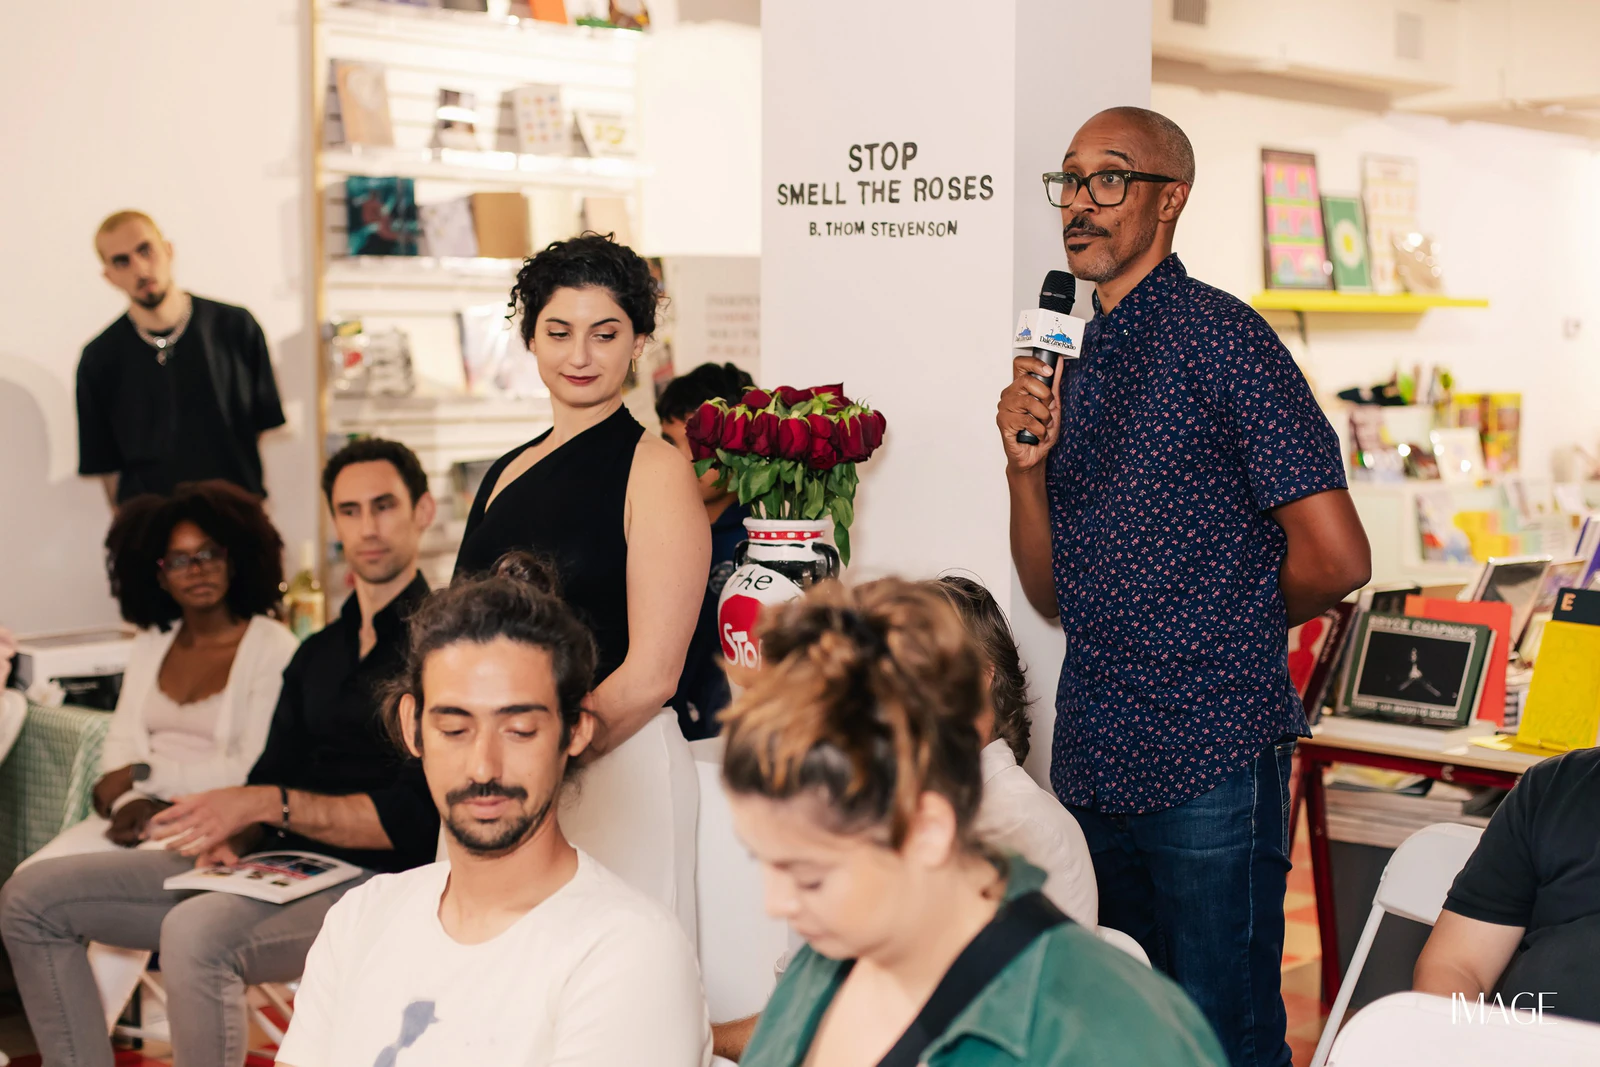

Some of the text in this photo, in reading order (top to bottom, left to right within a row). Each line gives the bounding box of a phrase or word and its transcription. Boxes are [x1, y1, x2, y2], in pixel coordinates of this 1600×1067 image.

[848, 141, 918, 172] STOP
[777, 175, 994, 206] SMELL THE ROSES
[809, 220, 958, 238] B. THOM STEVENSON
